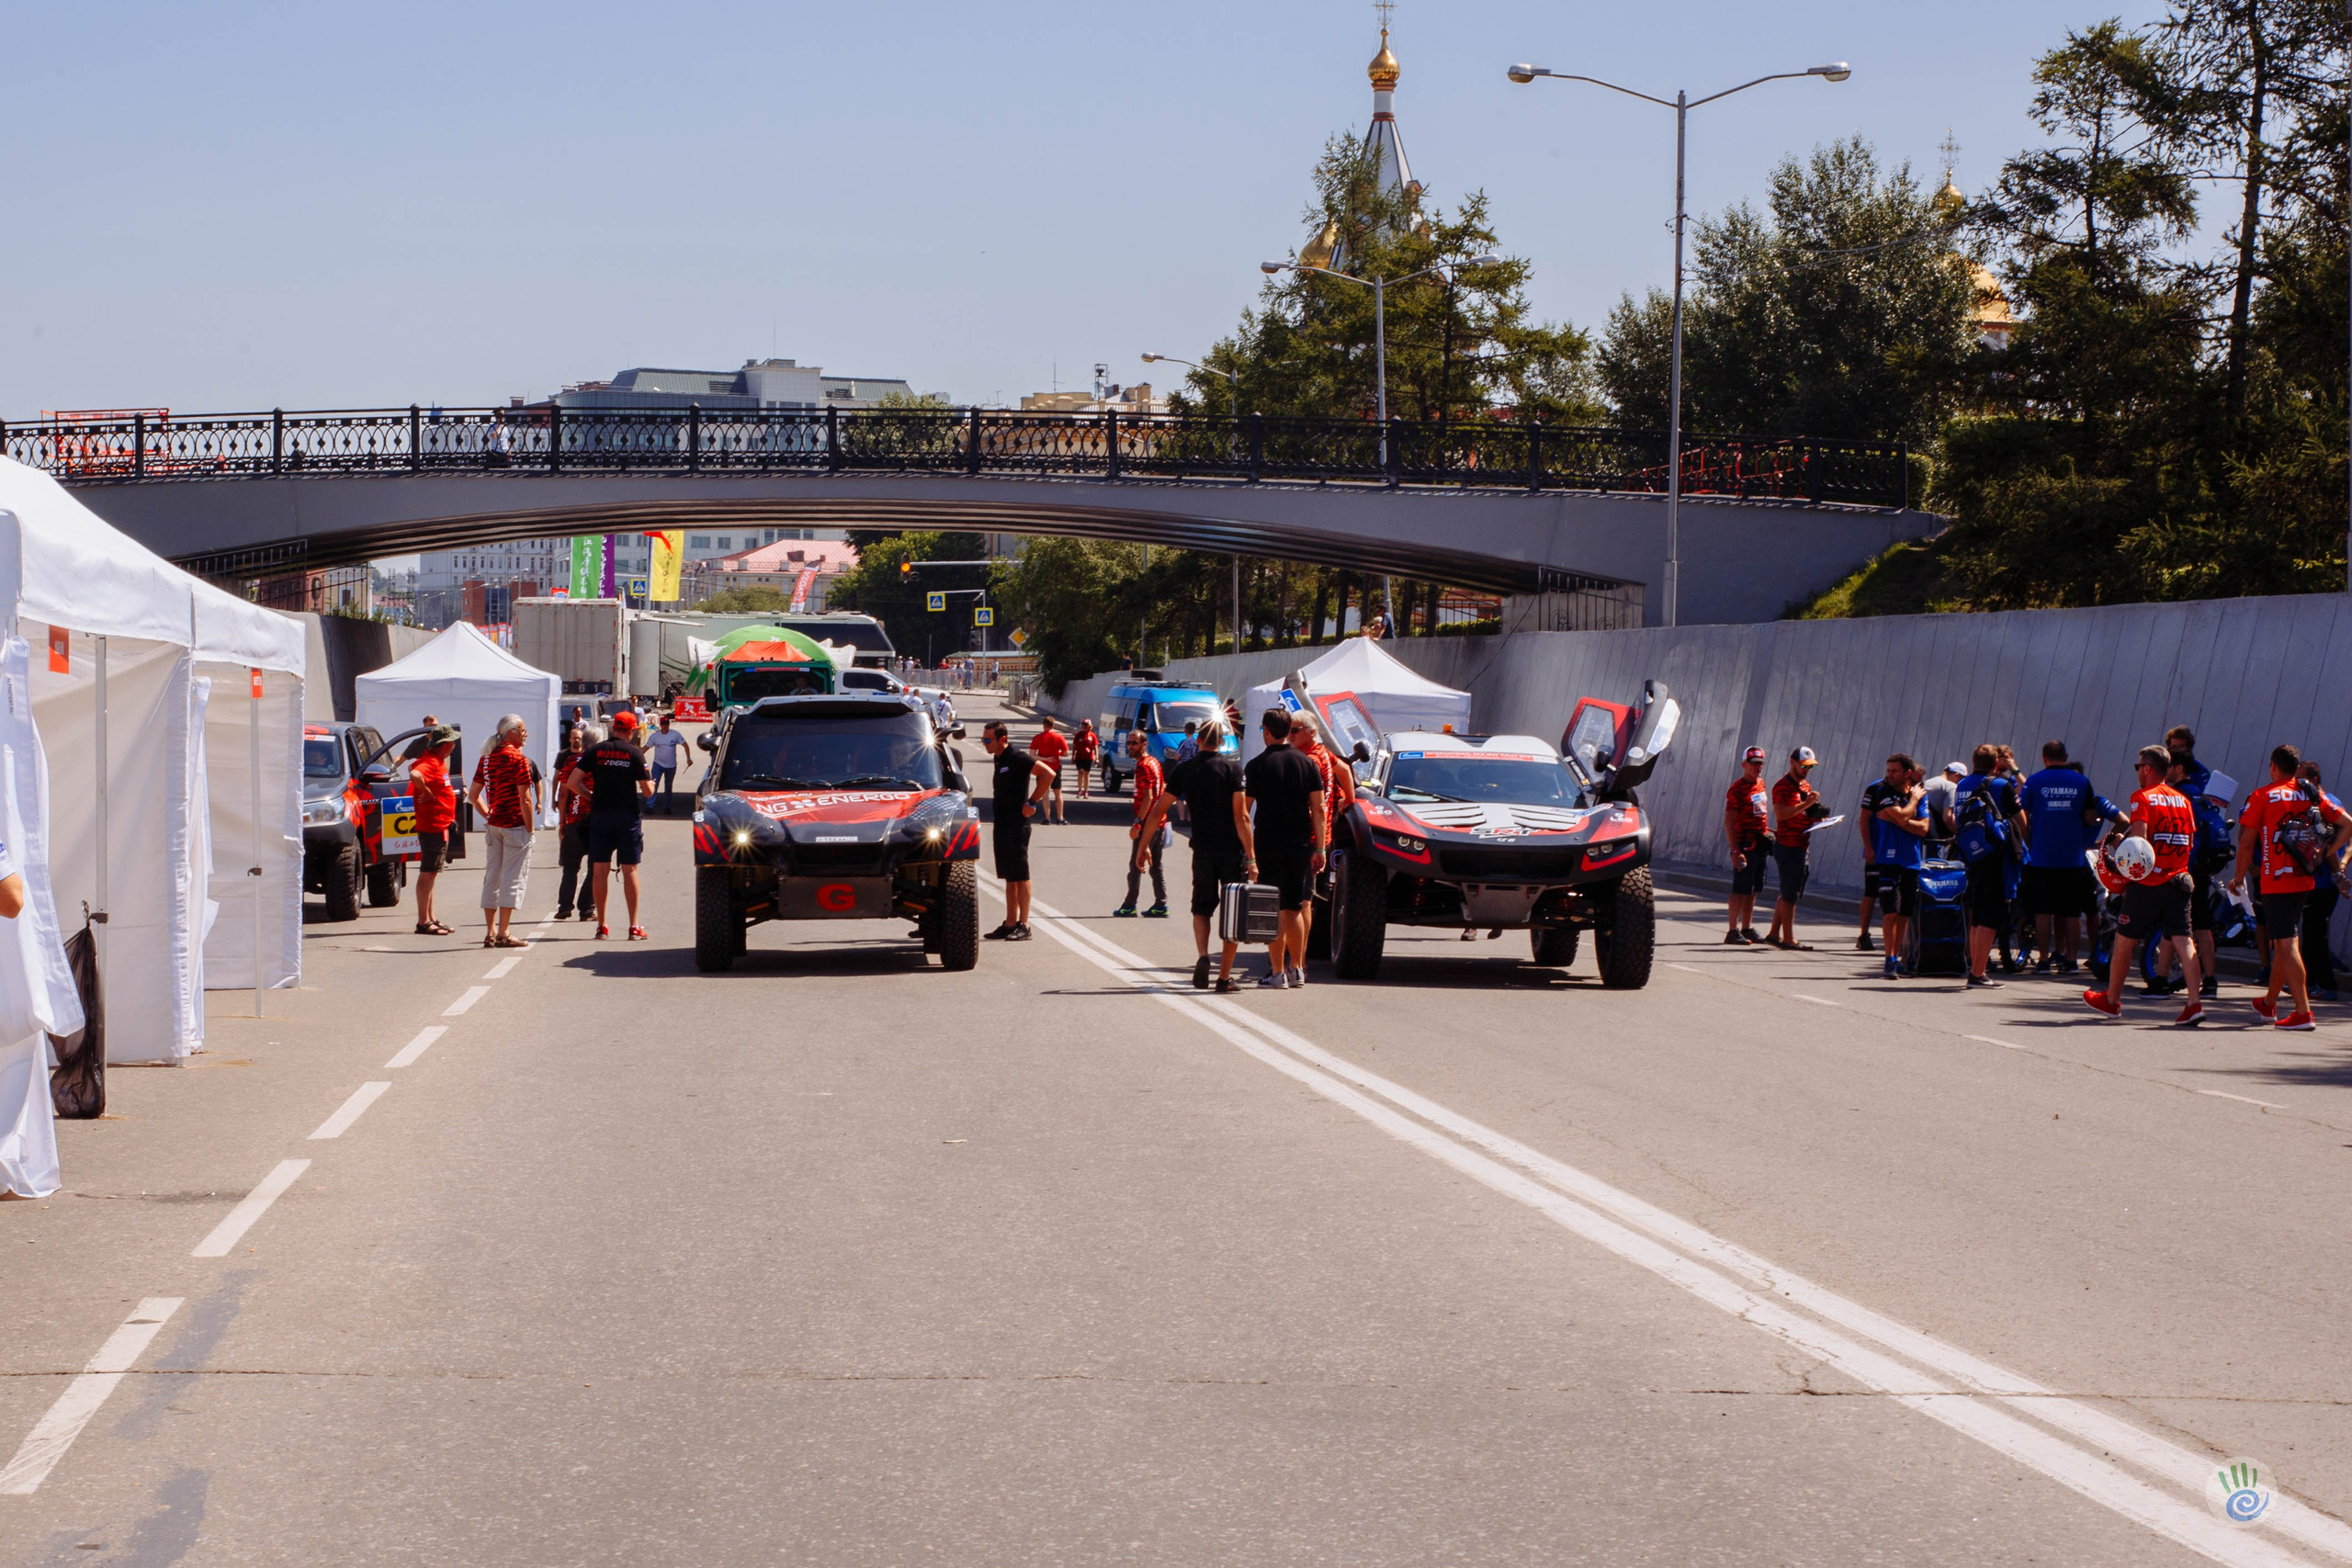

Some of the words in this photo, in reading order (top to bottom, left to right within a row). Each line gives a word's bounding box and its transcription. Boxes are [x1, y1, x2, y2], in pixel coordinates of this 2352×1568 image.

[795, 570, 811, 602] TOYOTA
[596, 750, 631, 760] RUSSIA
[2050, 787, 2078, 795] YAMAHA
[756, 801, 788, 814] NG
[818, 793, 910, 807] ENERGO
[2148, 794, 2188, 808] SONIK
[817, 884, 856, 911] G
